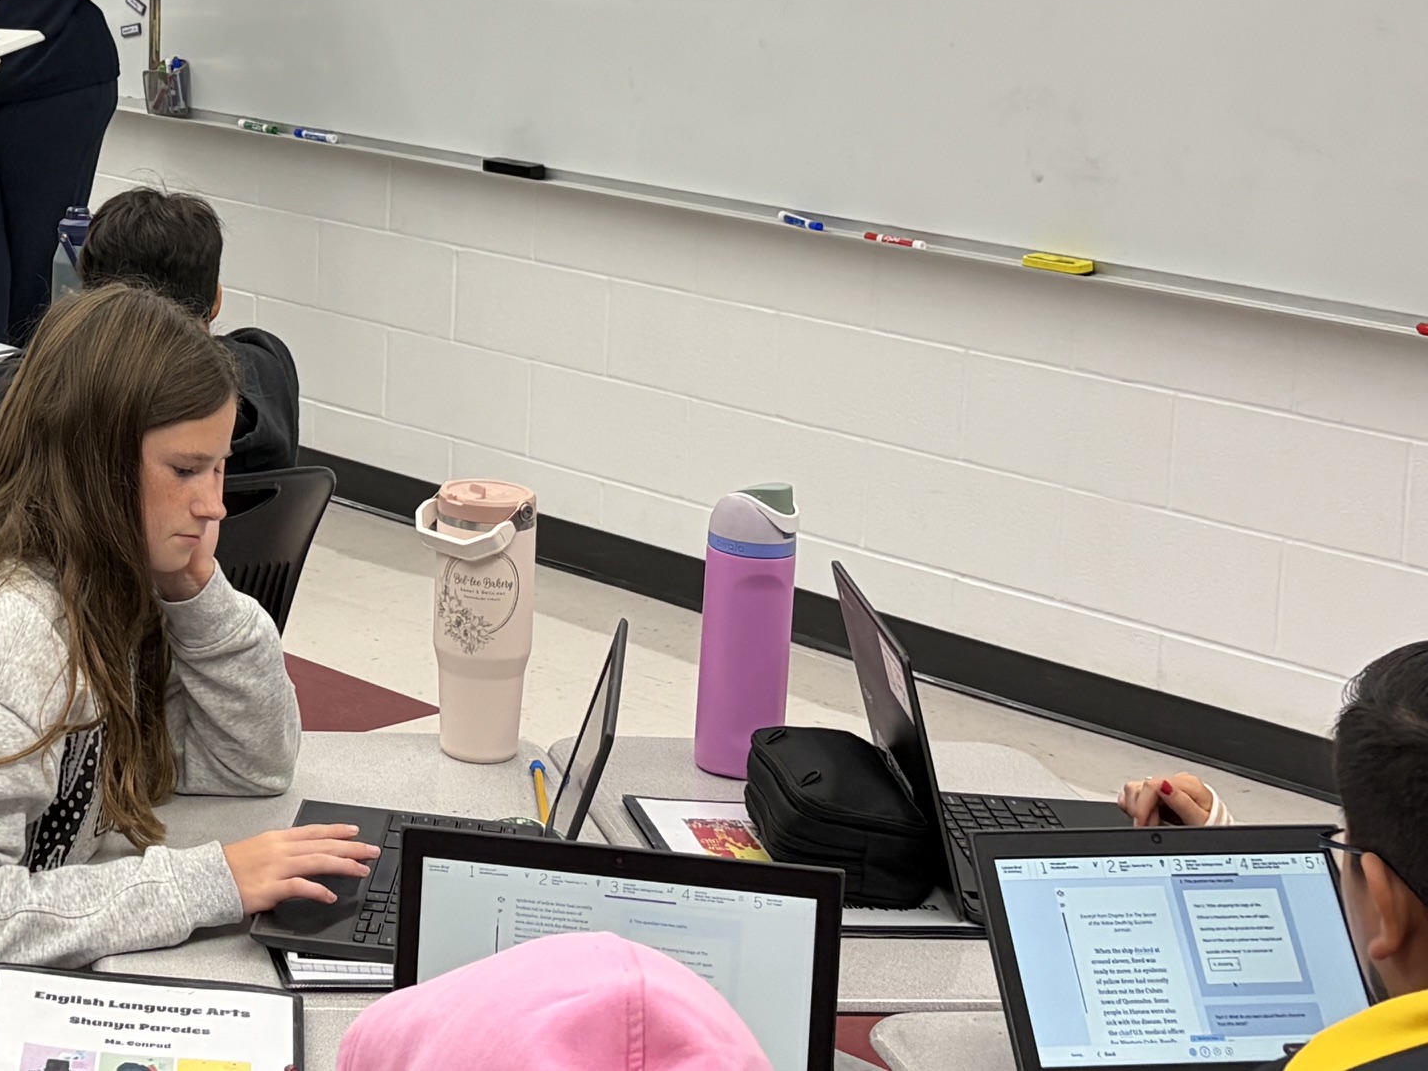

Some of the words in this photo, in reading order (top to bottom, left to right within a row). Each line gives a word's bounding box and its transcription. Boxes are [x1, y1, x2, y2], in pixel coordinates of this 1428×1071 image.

[1107, 859, 1117, 873] 2
[1173, 858, 1183, 871] 3
[1240, 857, 1249, 870] 4
[1305, 856, 1314, 869] 5
[539, 873, 548, 886] 2
[610, 881, 618, 893] 3
[681, 889, 690, 901] 4
[753, 897, 762, 909] 5
[34, 990, 104, 1008] English
[108, 999, 202, 1017] Language
[206, 1007, 251, 1018] Arts
[69, 1015, 136, 1031] Shanya
[139, 1022, 211, 1036] Paredes
[127, 1041, 171, 1049] Conrad
